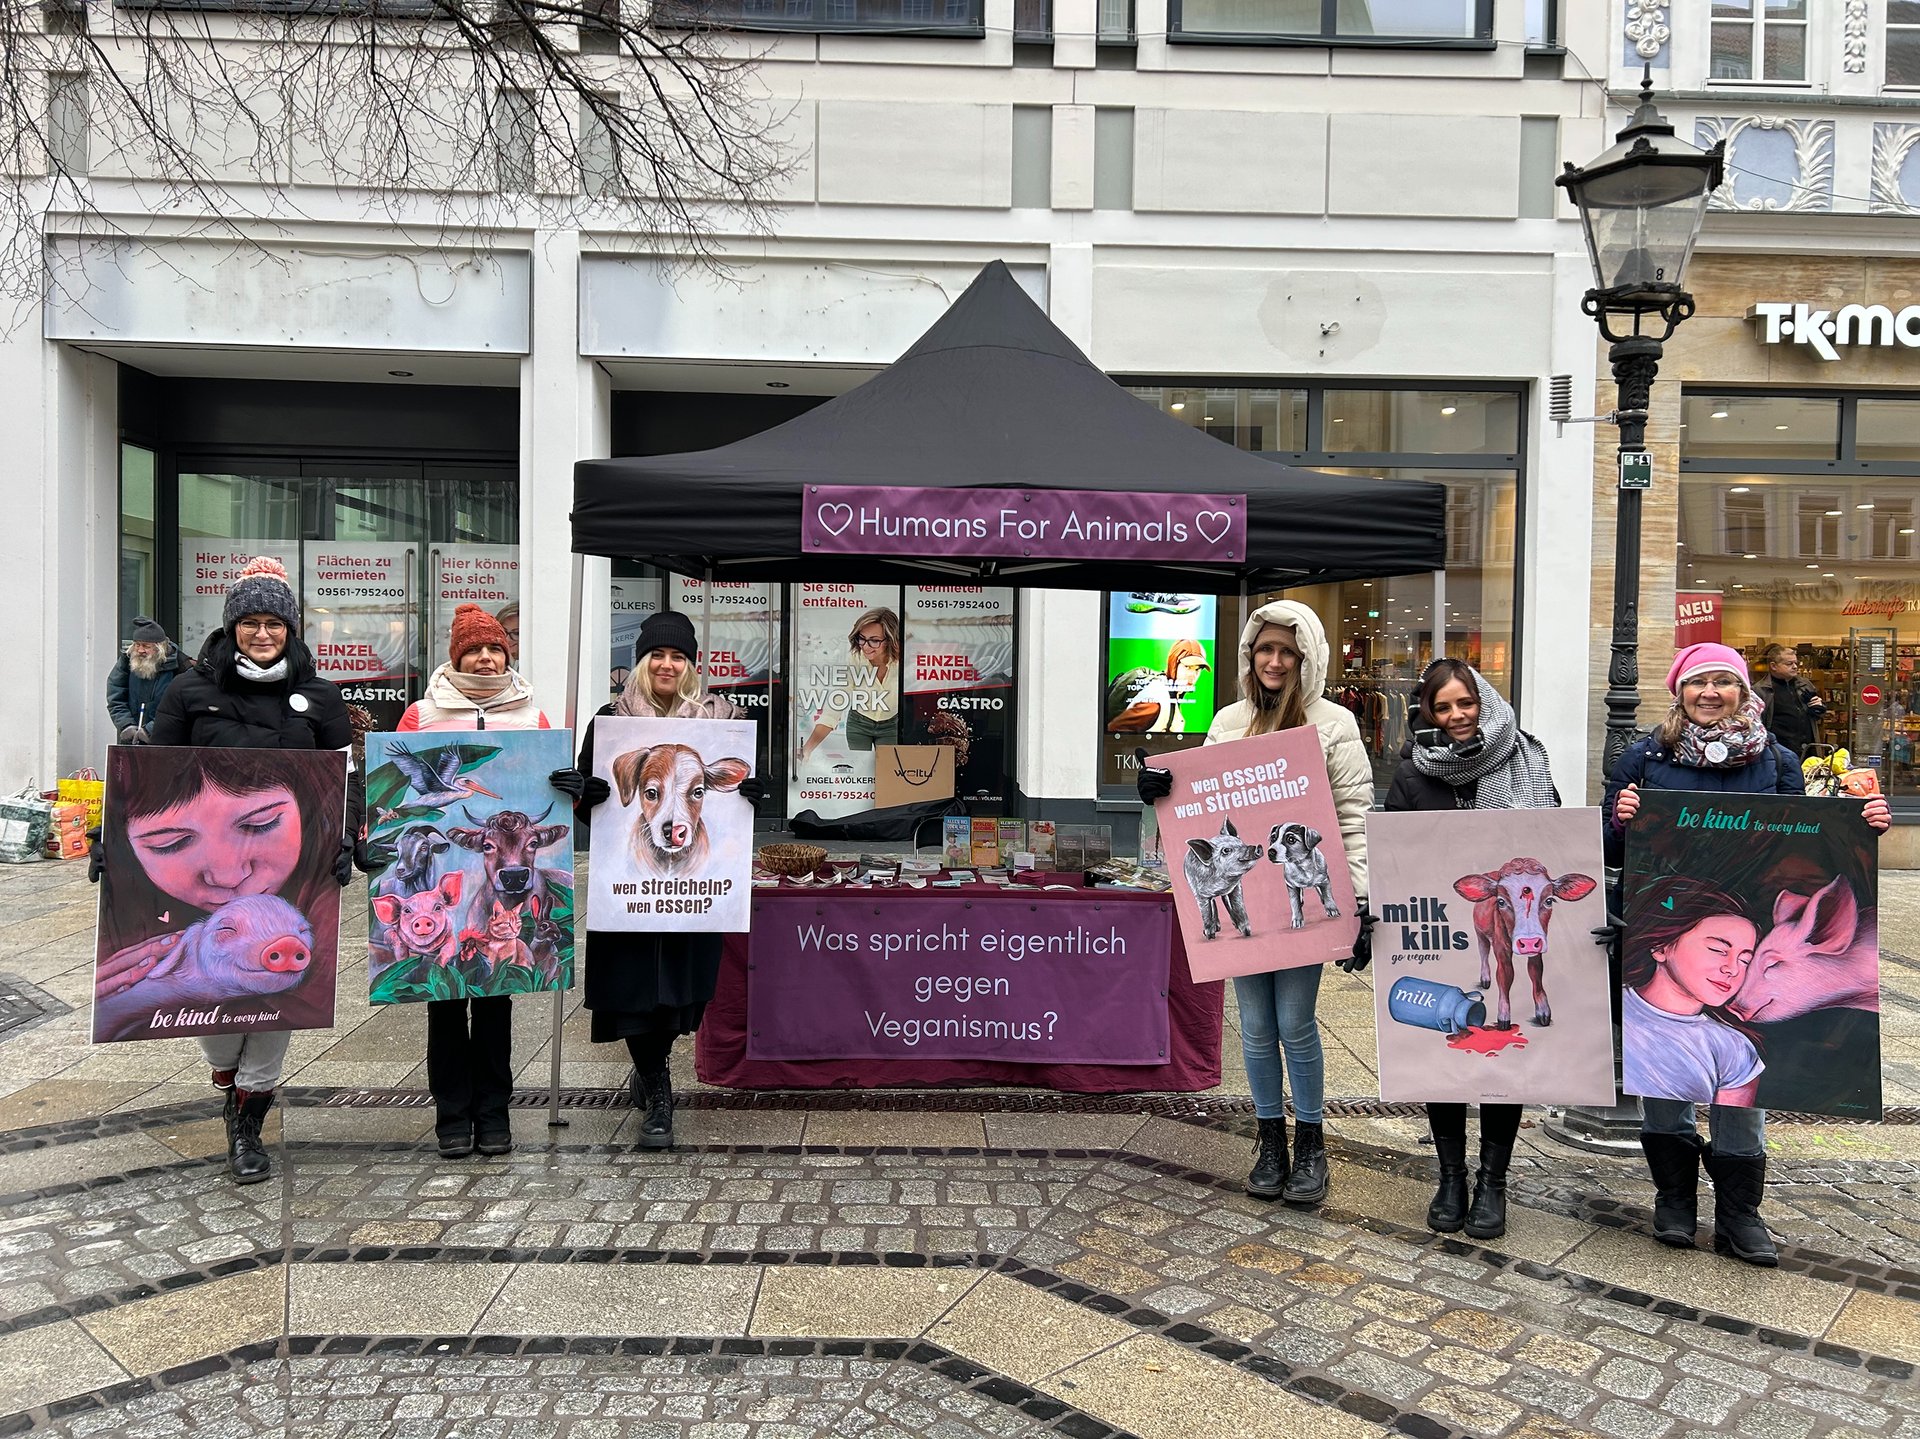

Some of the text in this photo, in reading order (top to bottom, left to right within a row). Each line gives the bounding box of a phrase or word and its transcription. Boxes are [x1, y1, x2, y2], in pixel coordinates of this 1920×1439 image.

[1656, 268, 1664, 281] 8
[860, 507, 1189, 543] Humans For Animals
[196, 552, 282, 565] Hier könn
[317, 555, 391, 567] Flächen zu
[442, 558, 520, 570] Hier könne
[196, 568, 241, 580] Sie sic
[317, 569, 386, 581] vermieten
[441, 573, 495, 585] Sie sich
[196, 583, 231, 595] entfa
[682, 578, 750, 588] verieten
[803, 583, 854, 593] Sie sich
[317, 587, 404, 598] 09561-7952400
[441, 588, 509, 600] entfalten.
[682, 594, 767, 605] 0951-7952400
[803, 596, 868, 609] entfalten.
[917, 600, 1000, 610] 09561-7952400
[1679, 600, 1713, 617] NEU
[1680, 614, 1715, 626] SHOPPEN
[317, 644, 377, 657] EINZEL
[317, 658, 388, 672] HANDEL
[916, 654, 973, 667] EINZEL
[810, 664, 879, 687] NEW
[916, 669, 983, 682] HANDEL
[719, 693, 768, 707] ASTRO
[799, 688, 890, 712] WORK
[936, 697, 1004, 710] GASTRO
[1191, 757, 1288, 795] wen essen?
[800, 790, 875, 800] 09561-795240
[1174, 775, 1309, 819] wen streicheln?
[1676, 806, 1821, 835] be kind to every kind
[612, 878, 733, 896] wen streicheln?
[626, 897, 713, 914] wen essen?
[1382, 897, 1449, 923] milk
[796, 923, 1127, 961] Was spricht eigentlich
[1401, 924, 1470, 950] kills
[1391, 953, 1442, 965] go vegan
[914, 974, 1011, 1003] gegen
[1395, 988, 1437, 1009] milk
[150, 1005, 281, 1029] be kind to every kind
[864, 1011, 1059, 1046] Veganismus?
